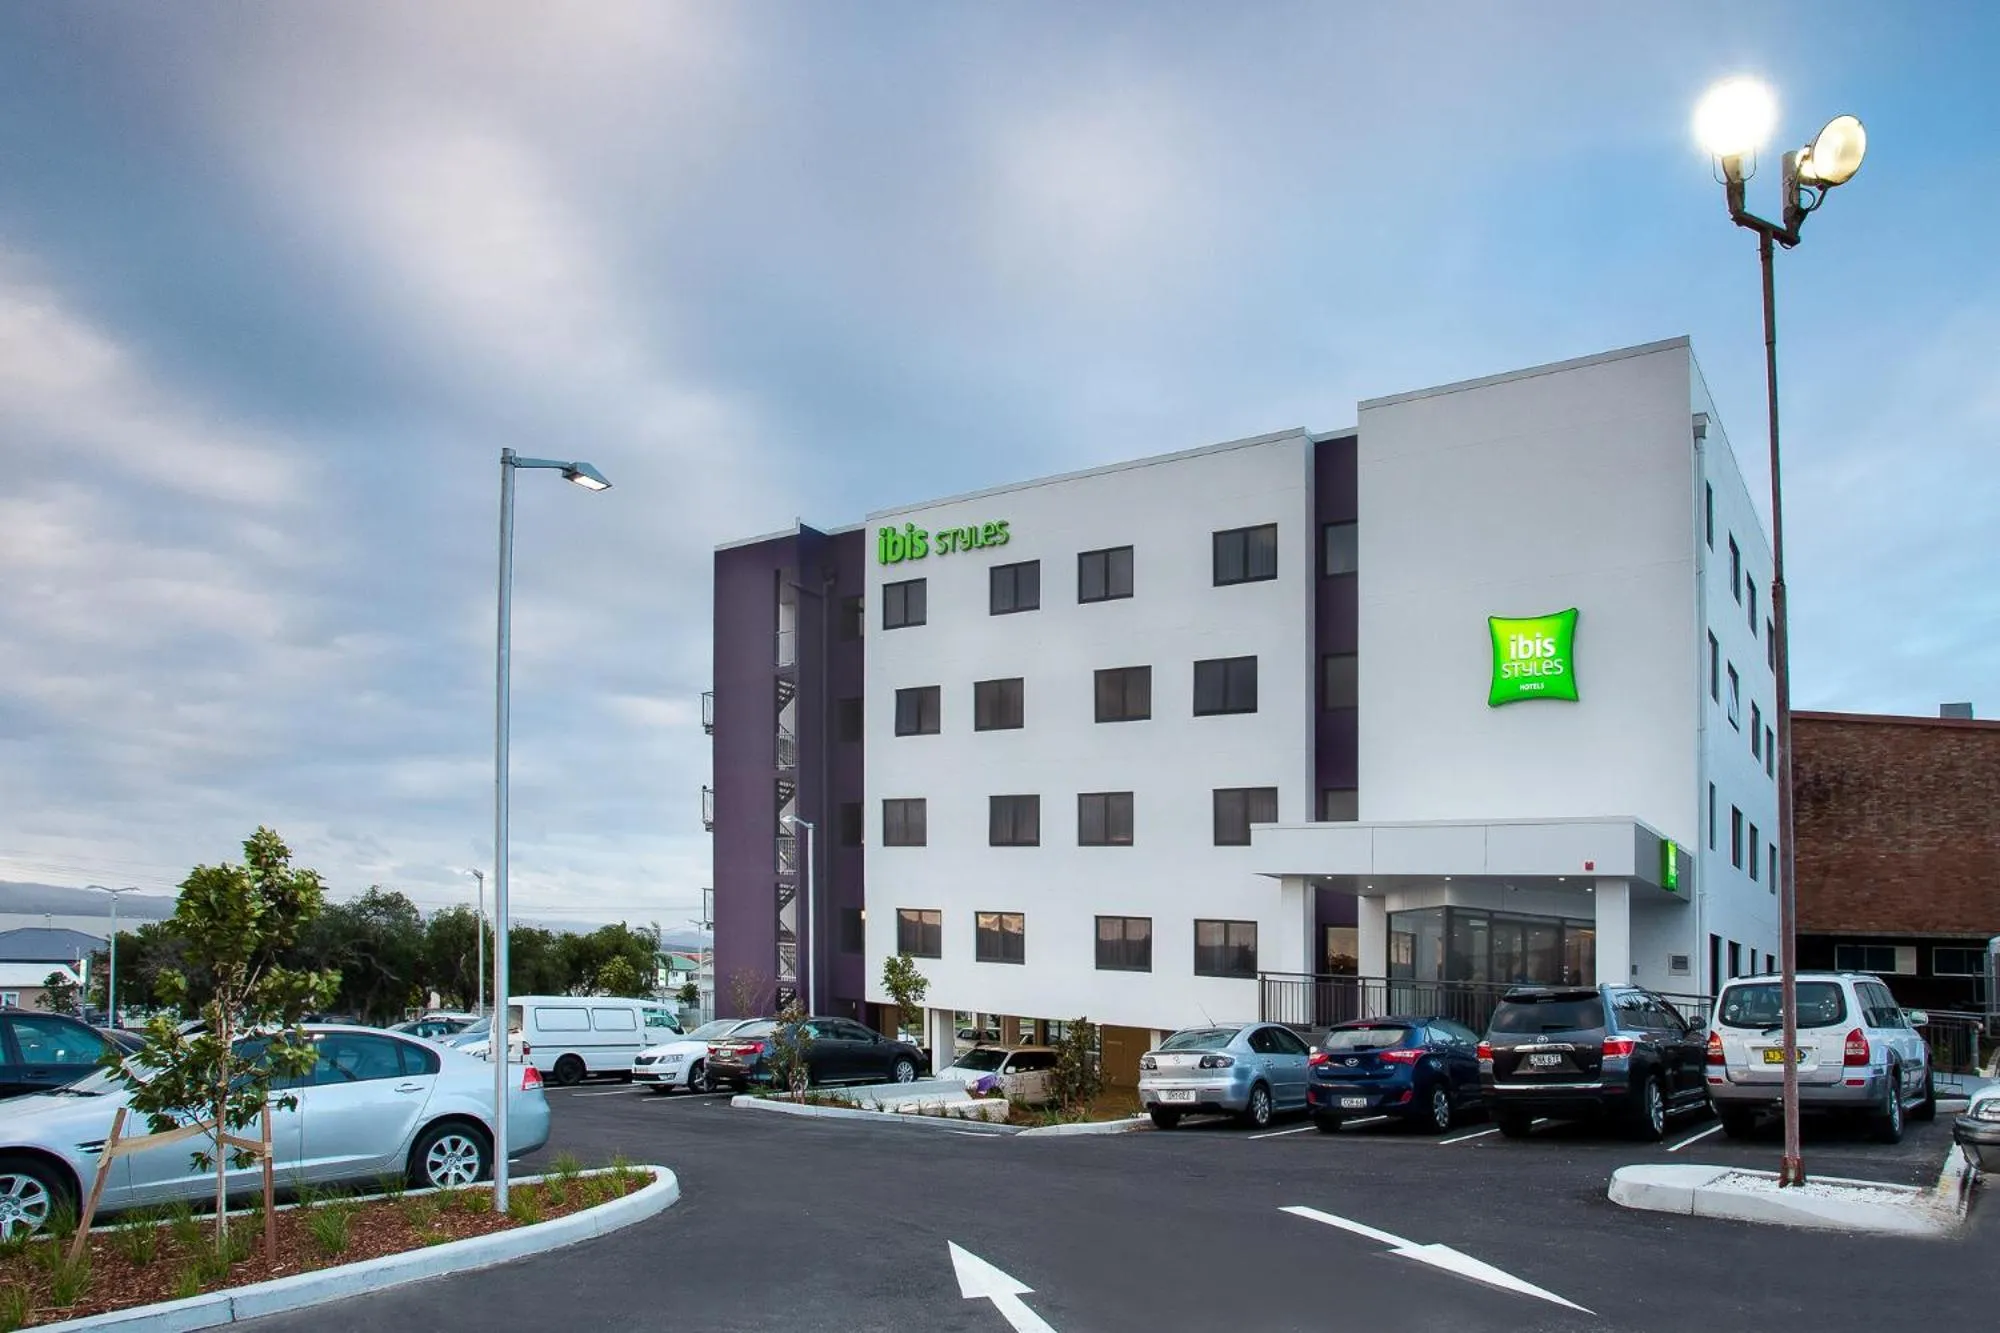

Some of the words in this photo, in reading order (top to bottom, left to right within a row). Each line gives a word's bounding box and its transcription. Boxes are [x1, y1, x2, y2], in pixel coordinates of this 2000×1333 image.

[878, 522, 928, 564] ibis
[1510, 632, 1555, 660] ibis
[1519, 682, 1545, 691] HOTELS
